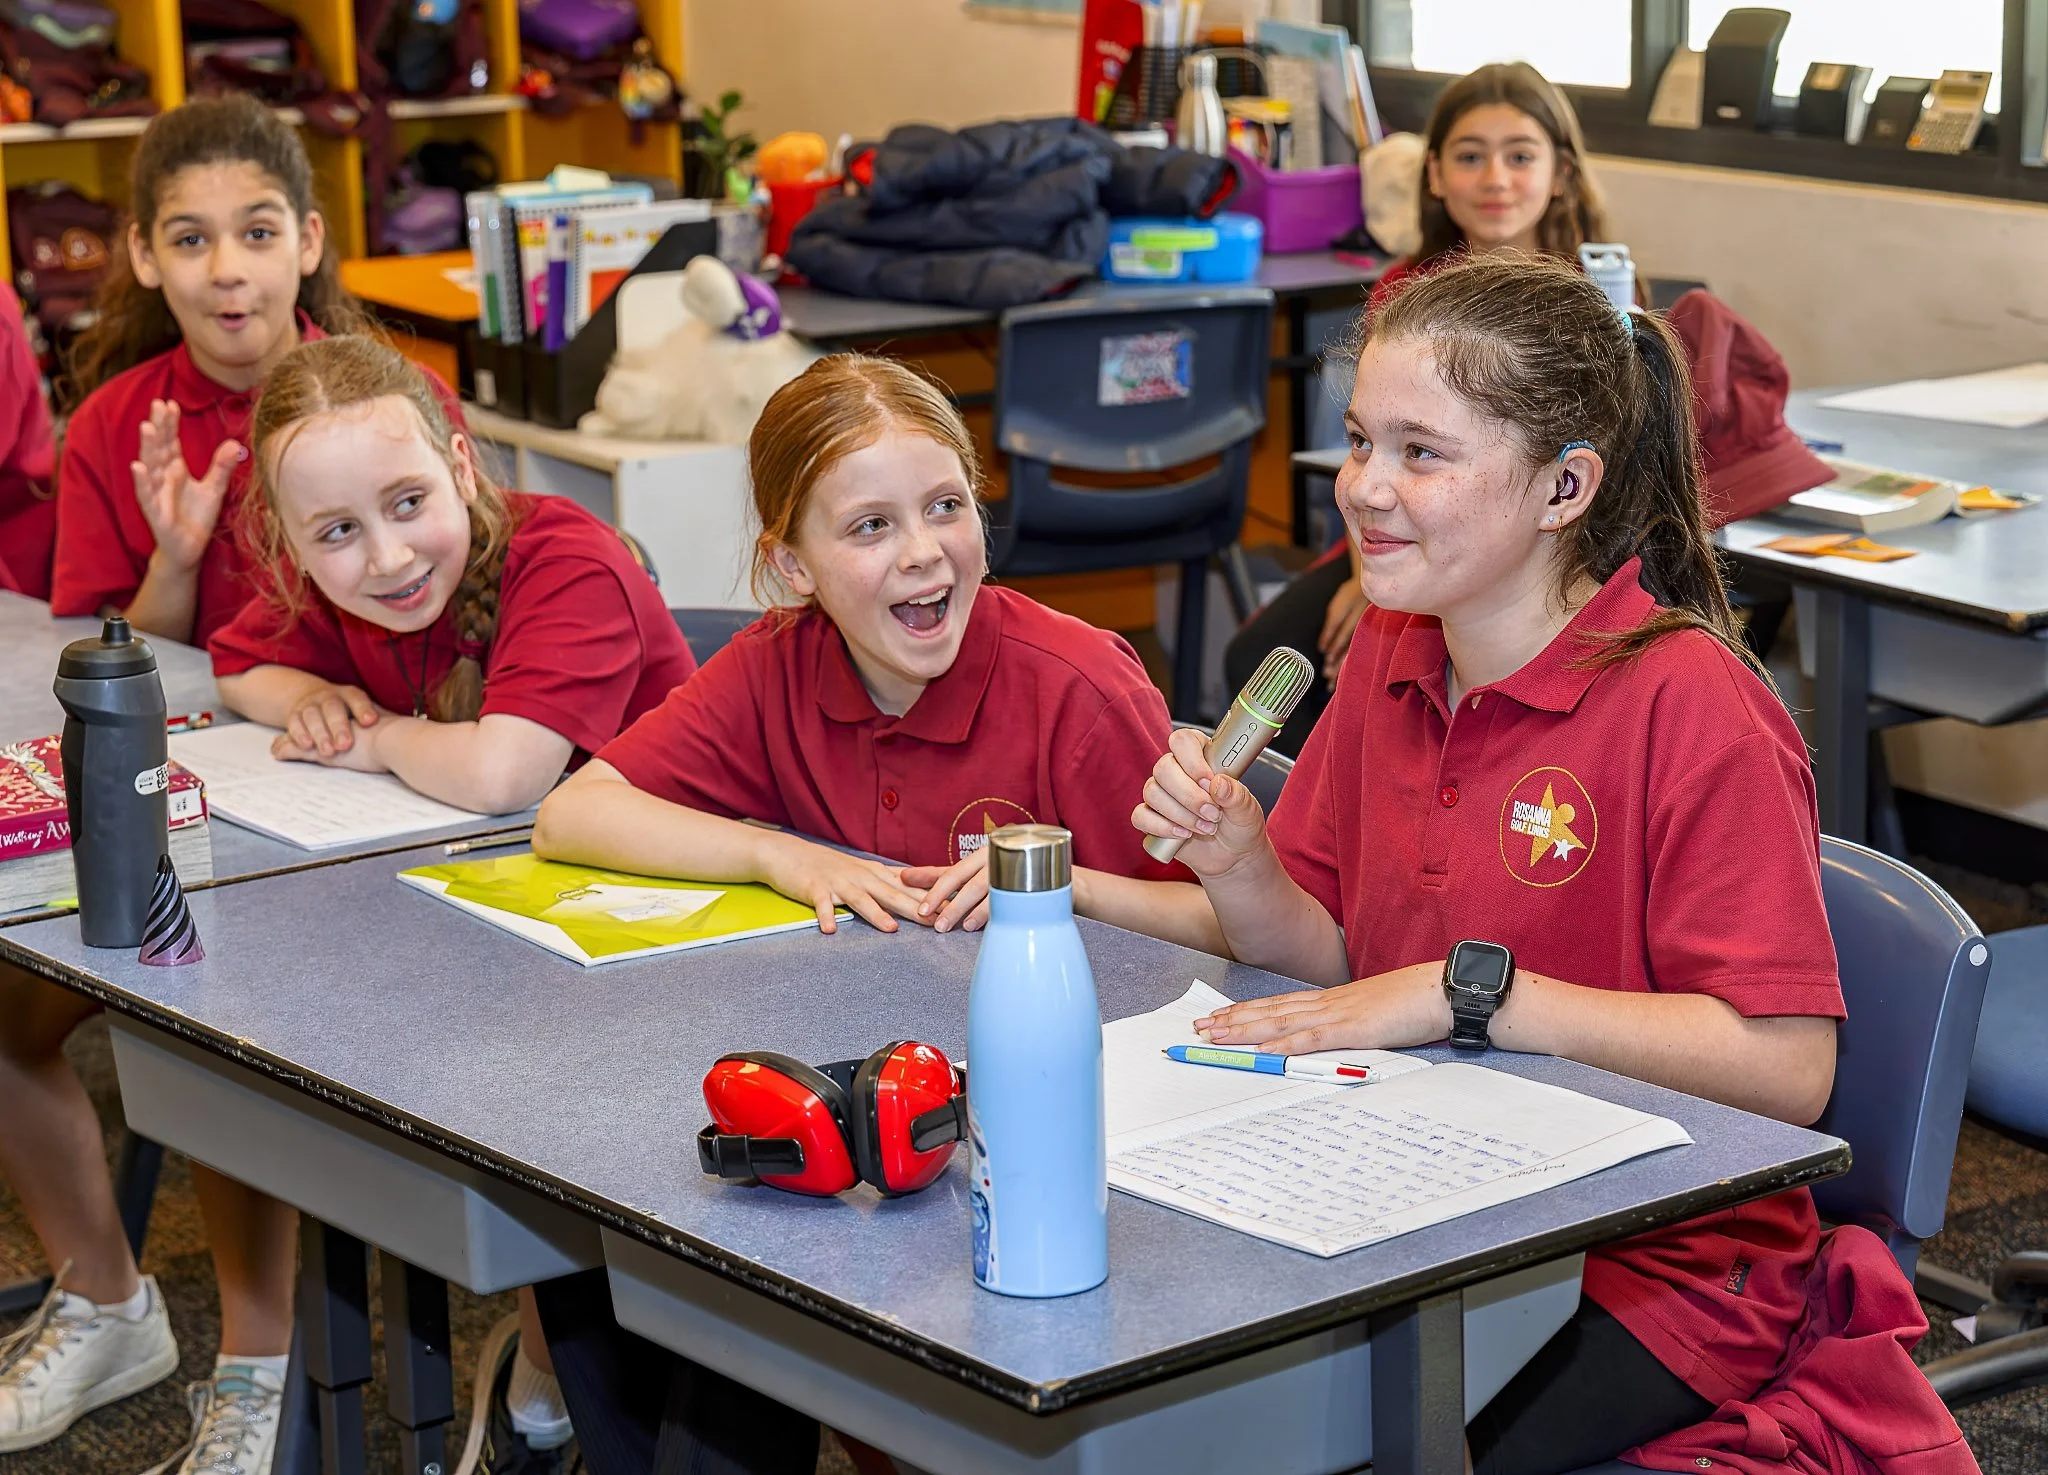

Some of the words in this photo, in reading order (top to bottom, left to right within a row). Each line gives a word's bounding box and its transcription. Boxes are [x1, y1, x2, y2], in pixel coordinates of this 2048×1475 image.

[1512, 800, 1551, 827] ROSANNA
[1511, 819, 1527, 833] GOLF
[1527, 823, 1550, 838] LINKS
[1219, 1054, 1242, 1064] Arthur
